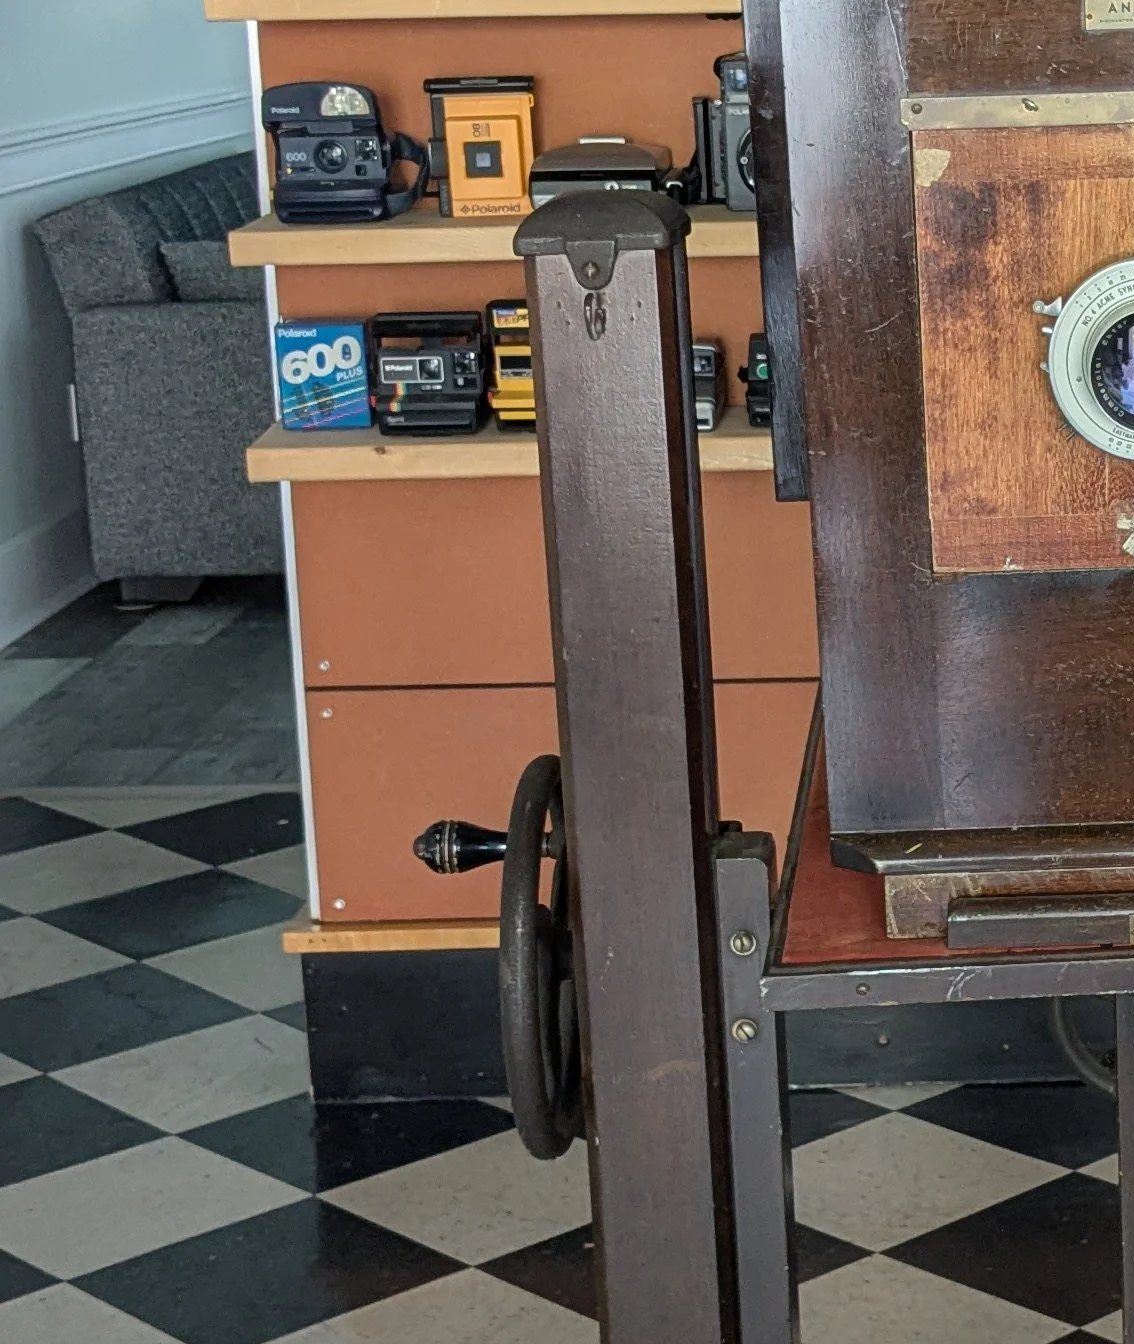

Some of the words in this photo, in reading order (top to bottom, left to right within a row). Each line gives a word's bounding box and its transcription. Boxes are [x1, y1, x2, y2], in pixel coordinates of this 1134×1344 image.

[286, 152, 307, 162] 600
[472, 203, 521, 214] Polaroid
[1096, 292, 1115, 310] ACME
[278, 329, 316, 338] Polaroid
[282, 335, 361, 384] 600
[336, 367, 363, 381] PLUS
